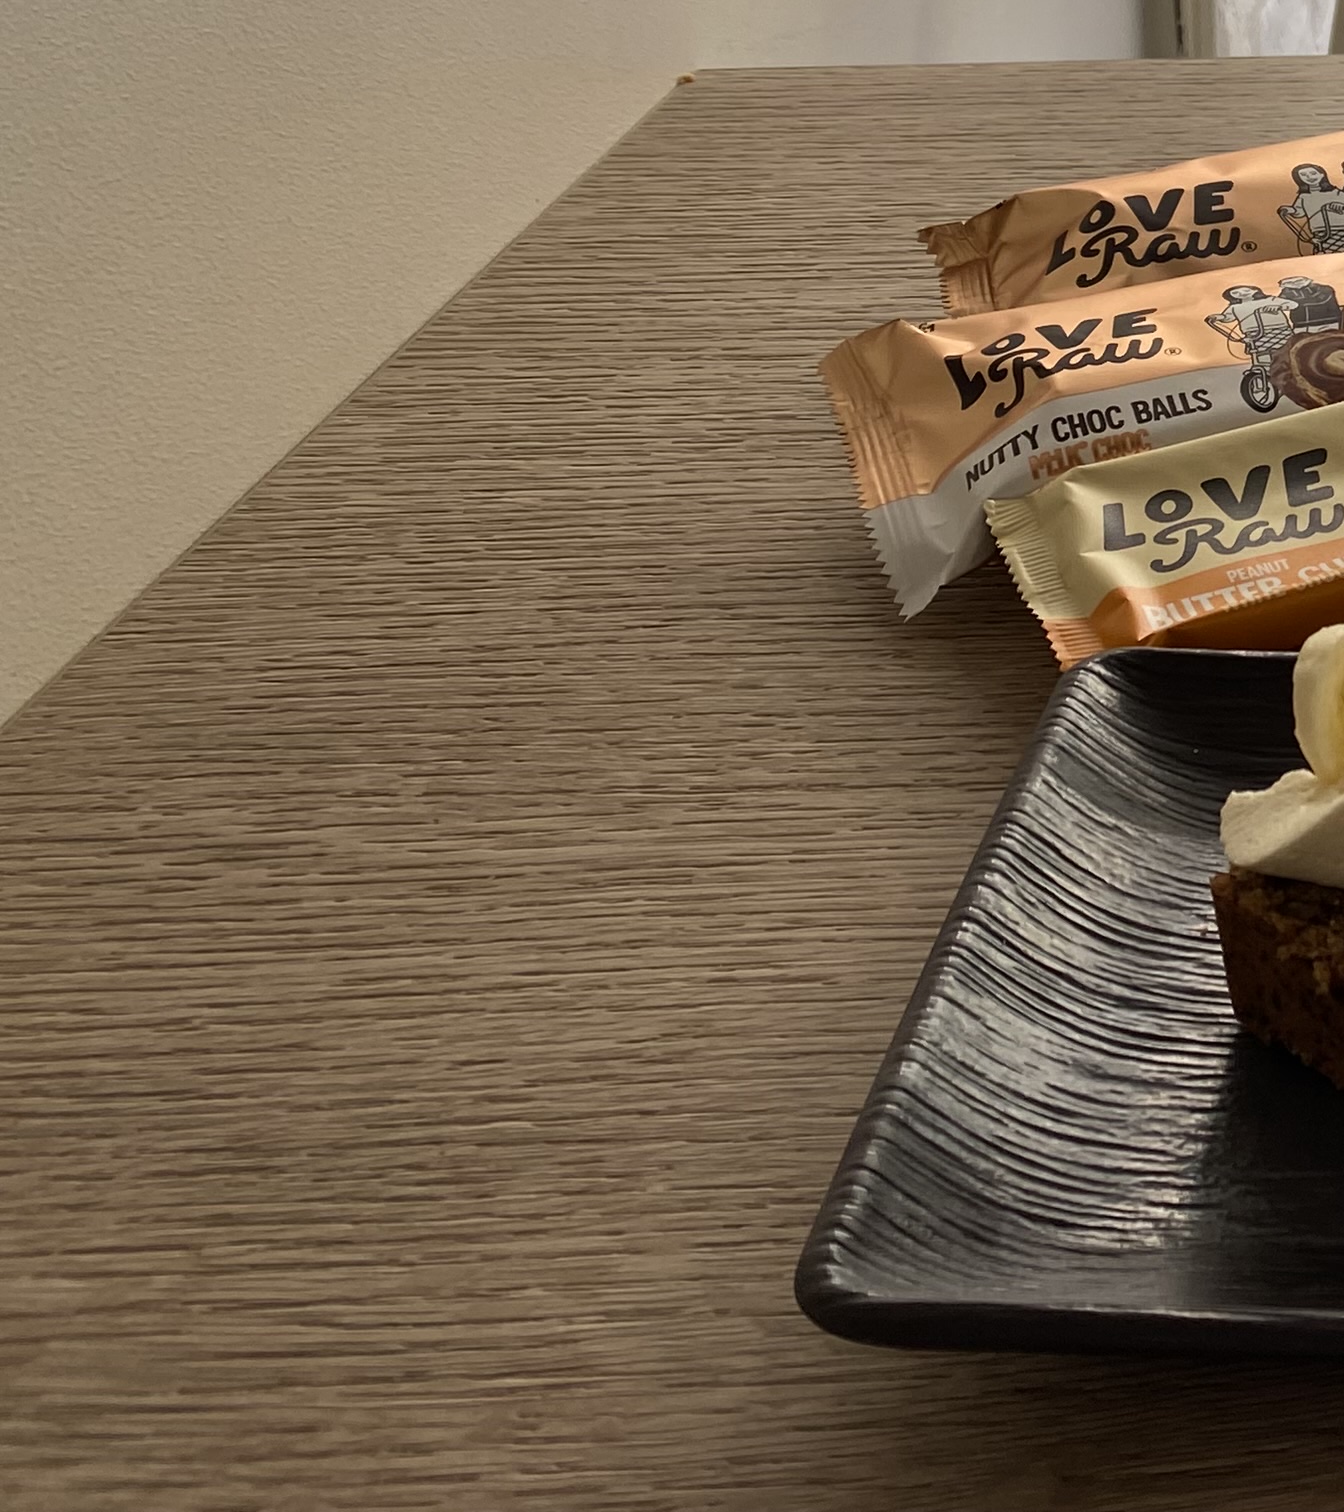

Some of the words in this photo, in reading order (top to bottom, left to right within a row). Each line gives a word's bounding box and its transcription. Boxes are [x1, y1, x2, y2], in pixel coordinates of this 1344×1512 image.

[1045, 180, 1235, 276] LOVE
[1076, 225, 1241, 288] Raw
[943, 307, 1159, 411] LOVE
[986, 337, 1164, 419] Raw
[964, 423, 1041, 492] NUTTY
[1050, 404, 1125, 442] CHOC
[1130, 388, 1214, 425] BALLS
[1102, 447, 1335, 552] LOVE
[1140, 574, 1287, 633] BUTTER
[1225, 557, 1292, 584] PEANUT
